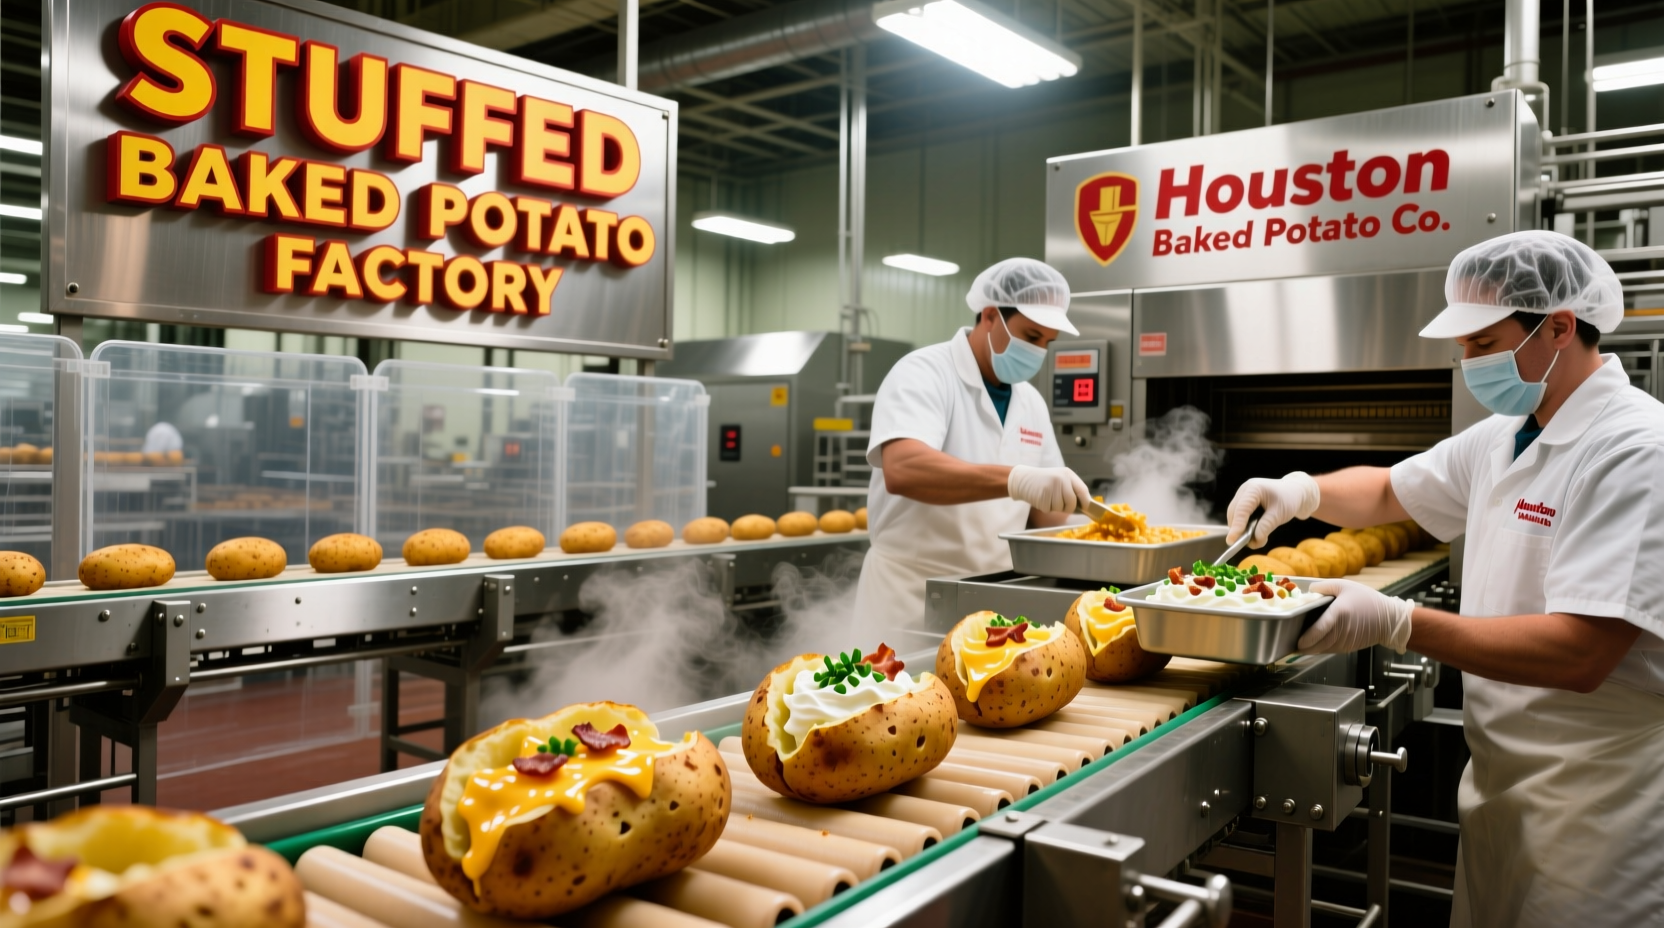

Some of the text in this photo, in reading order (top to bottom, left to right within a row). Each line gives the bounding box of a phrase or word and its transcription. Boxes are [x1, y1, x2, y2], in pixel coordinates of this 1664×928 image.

[118, 2, 641, 198] STUFFED
[107, 130, 656, 267] BAKED POTATO
[1155, 149, 1450, 219] Houston
[1152, 204, 1450, 256] Baked Potato Co.
[265, 234, 563, 315] FACTORY
